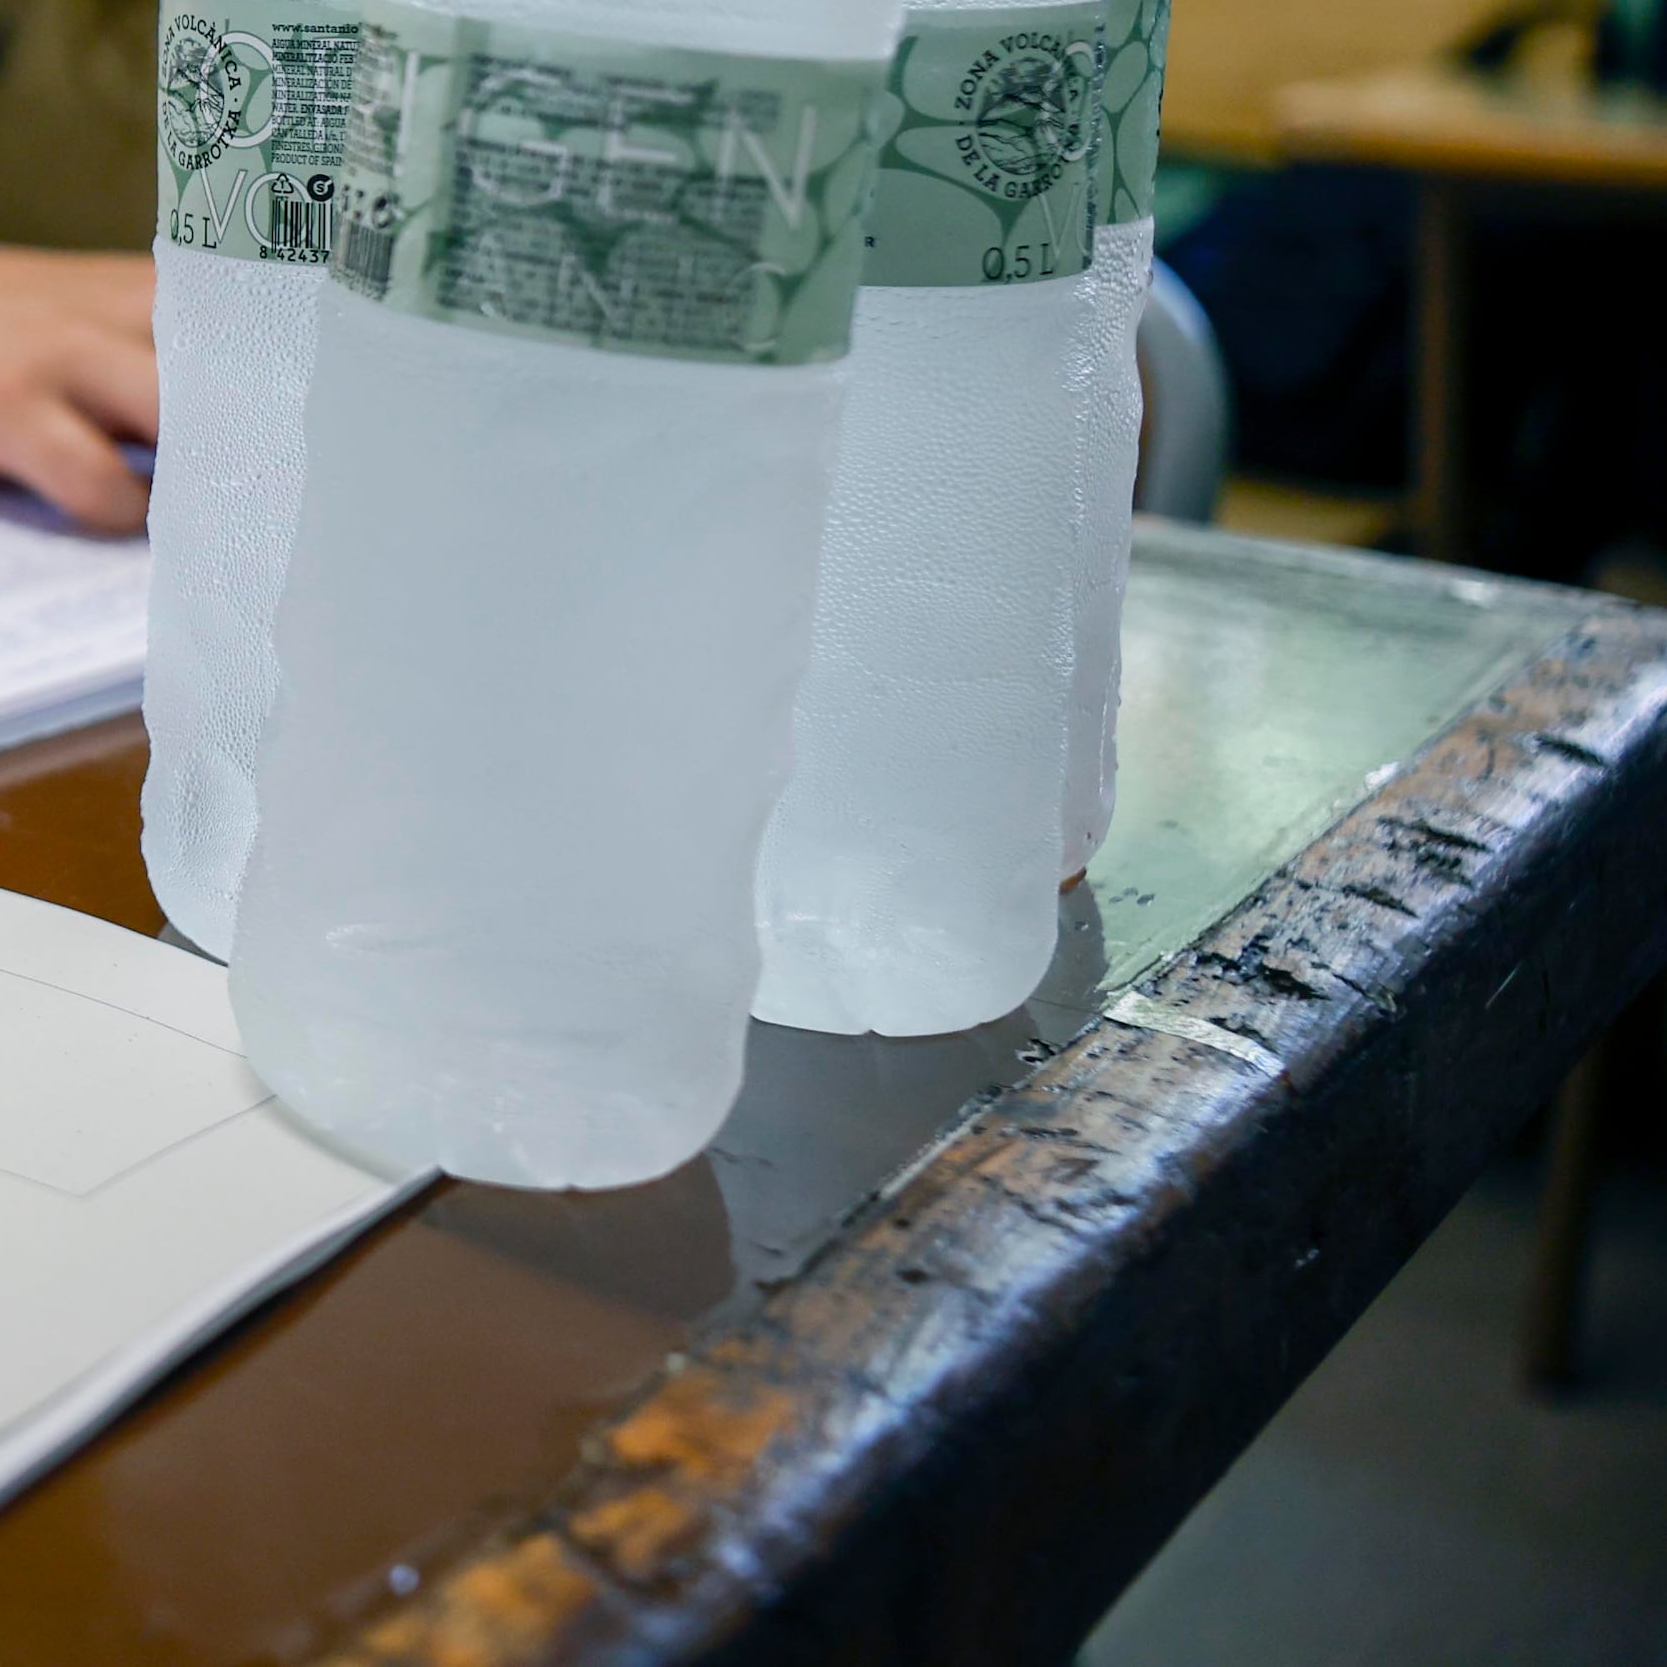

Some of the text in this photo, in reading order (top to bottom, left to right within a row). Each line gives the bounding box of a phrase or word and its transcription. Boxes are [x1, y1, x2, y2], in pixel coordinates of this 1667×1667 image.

[271, 22, 362, 34] www.santanio
[174, 14, 242, 91] VOLCÀNICA
[953, 49, 1001, 111] ZONA
[178, 109, 242, 171] GARROTXA
[271, 152, 306, 165] PRODUCT
[308, 154, 320, 166] OF
[955, 135, 981, 166] DE
[973, 164, 1001, 192] LA
[170, 209, 217, 249] 0,5 L
[259, 245, 330, 264] 8 42437
[982, 245, 1032, 284] 0,5
